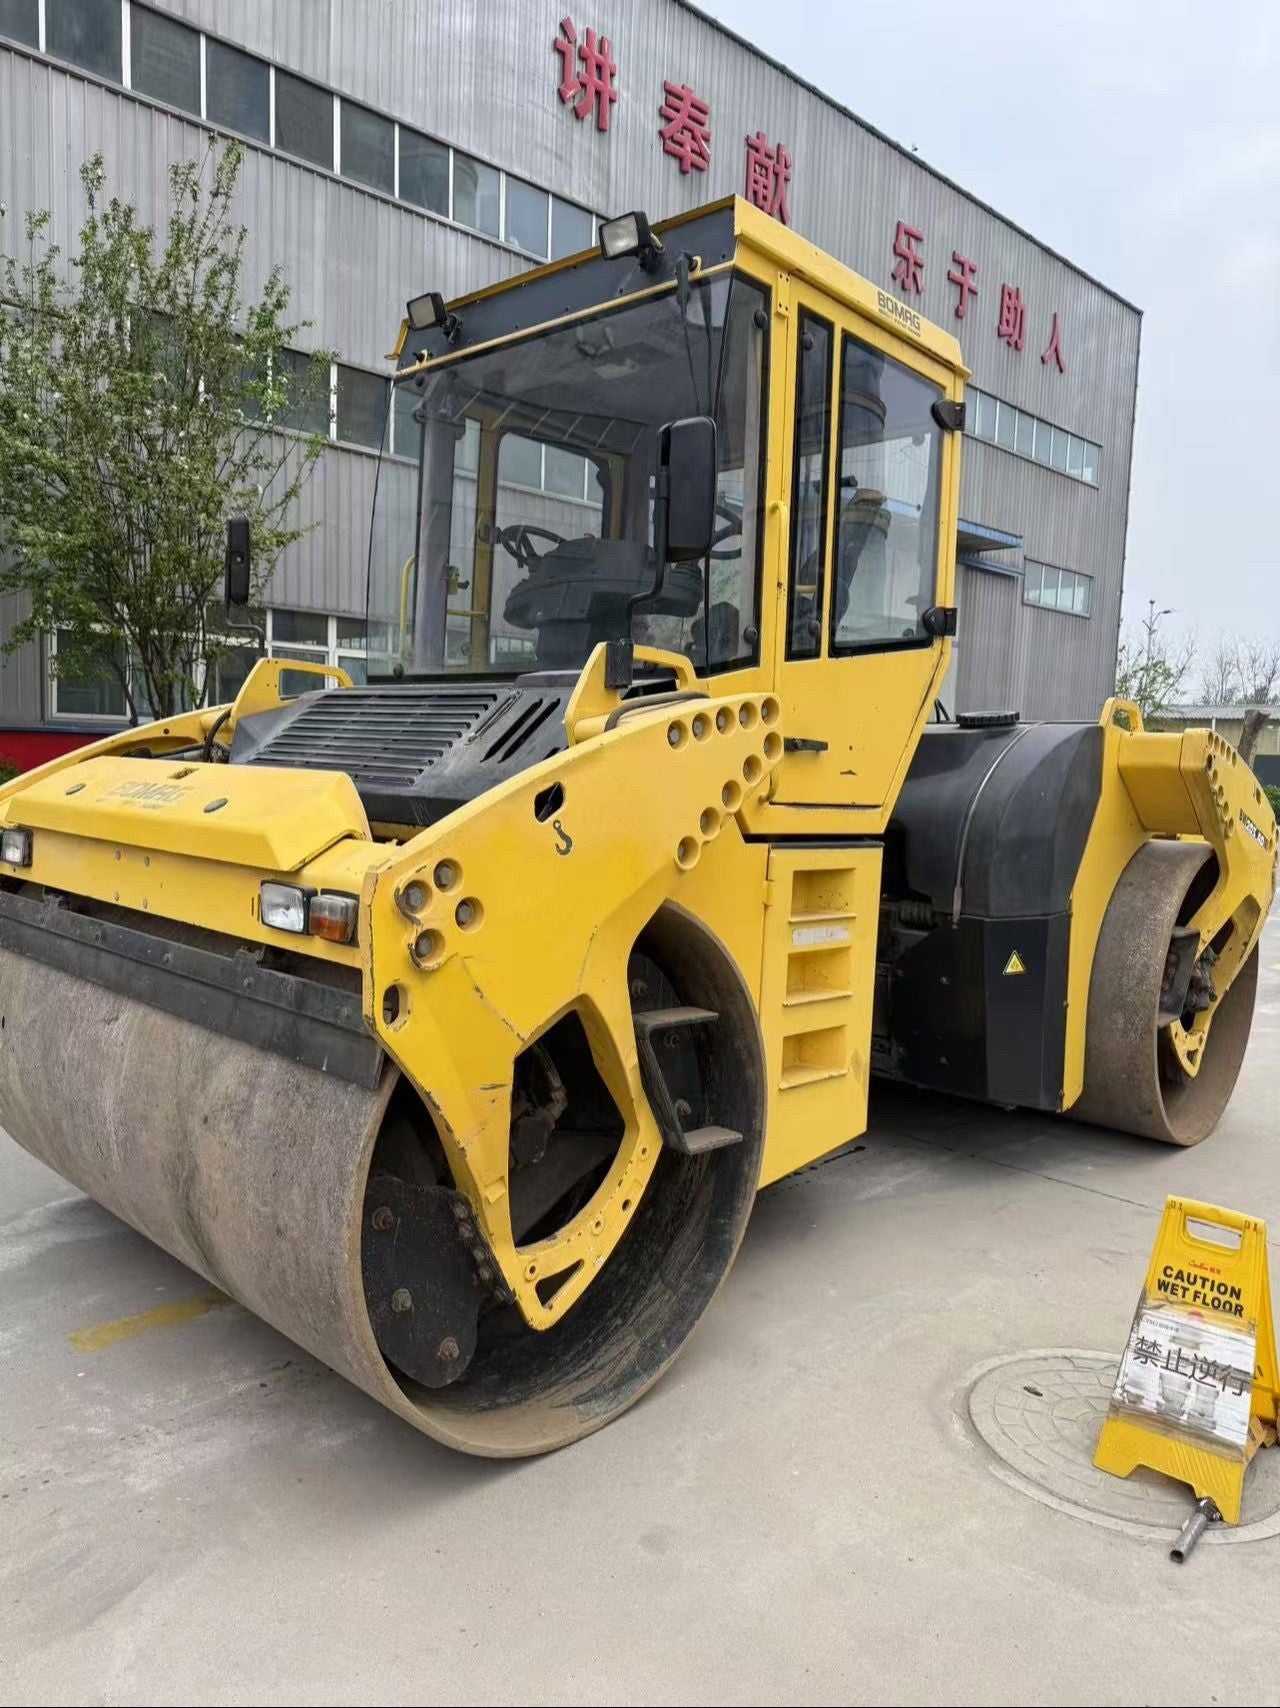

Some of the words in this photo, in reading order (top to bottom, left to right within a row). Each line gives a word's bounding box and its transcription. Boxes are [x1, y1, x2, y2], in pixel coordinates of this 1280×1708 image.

[554, 16, 793, 225] 讲奉献
[891, 220, 1067, 374] 乐于助人
[877, 290, 921, 332] BOMAG
[1157, 1278, 1190, 1299] WET
[1193, 1290, 1244, 1318] FLOOR
[1163, 1265, 1242, 1300] CAUTION
[1133, 1336, 1253, 1397] 禁止逆行
